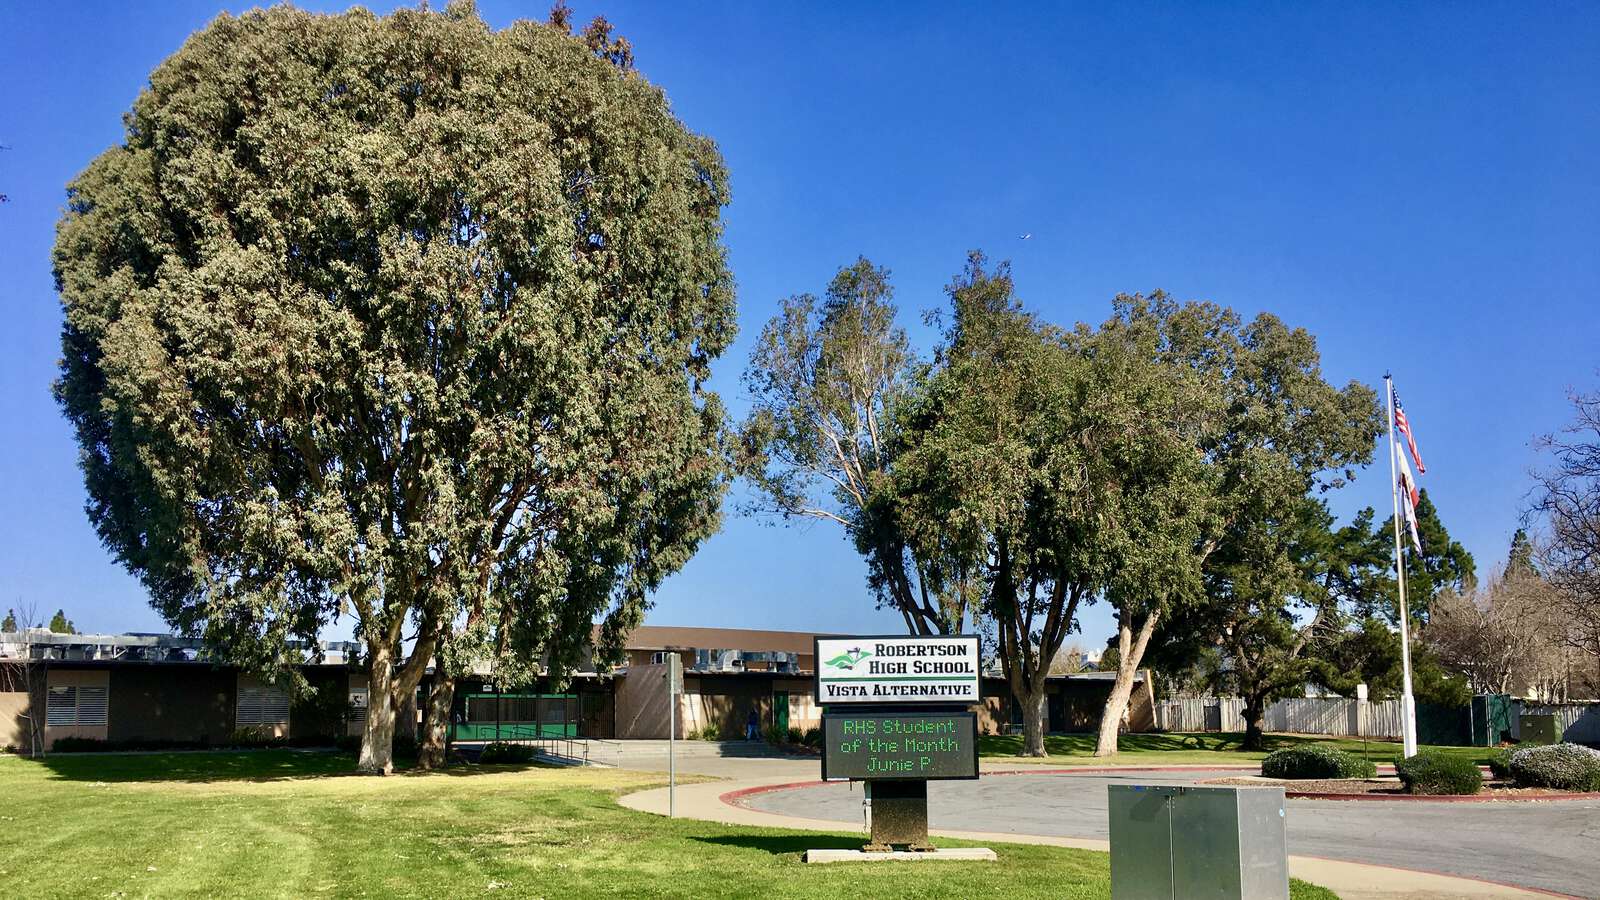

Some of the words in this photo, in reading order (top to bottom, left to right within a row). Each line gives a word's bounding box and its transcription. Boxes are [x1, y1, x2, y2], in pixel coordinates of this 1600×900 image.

[875, 644, 967, 657] ROBERTSON
[869, 661, 907, 674] HIGH
[914, 661, 974, 674] SCHOOL
[827, 685, 867, 696] VISTA
[873, 685, 971, 696] ALTERNATIVE
[843, 721, 876, 734] RHS
[883, 720, 956, 733] Student
[841, 739, 861, 753] of
[869, 739, 898, 752] the
[906, 739, 960, 752] Month
[867, 757, 913, 771] Junie
[920, 757, 936, 770] P.
